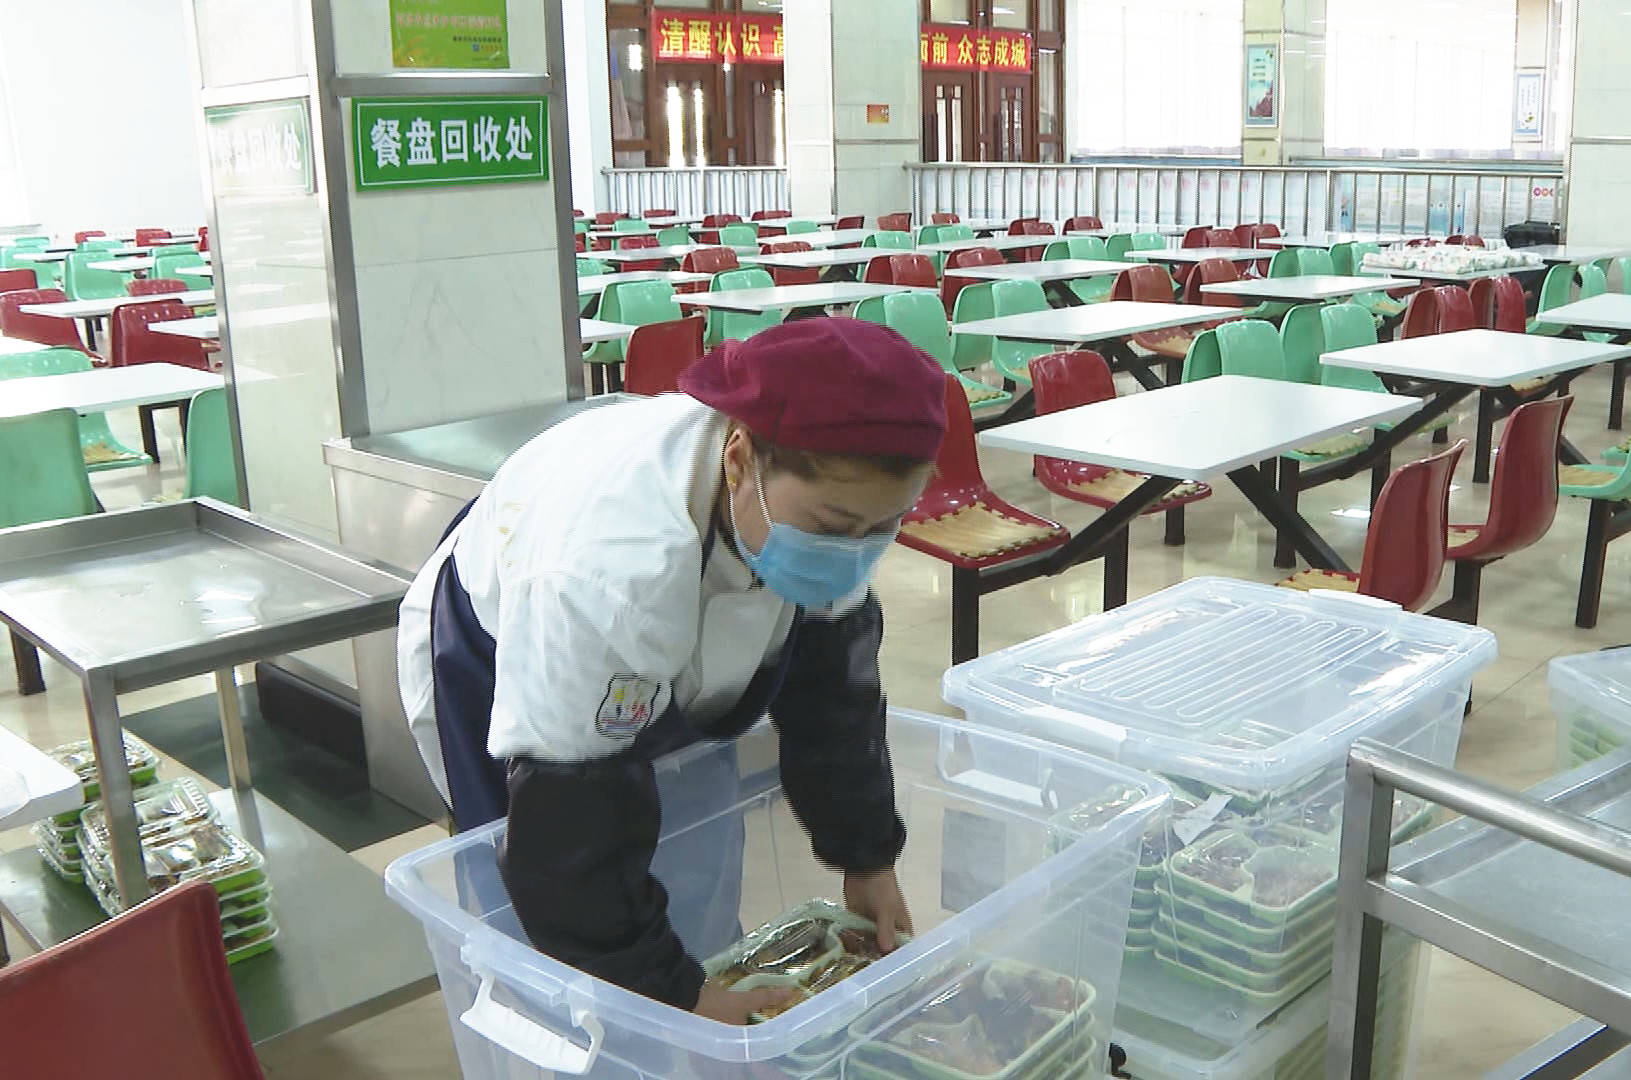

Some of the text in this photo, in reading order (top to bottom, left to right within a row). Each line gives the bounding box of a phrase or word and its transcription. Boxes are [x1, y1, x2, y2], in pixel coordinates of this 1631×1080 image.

[659, 18, 762, 57] 清醒认识
[957, 34, 1027, 68] 众志成城
[370, 115, 534, 170] 餐盘回收处
